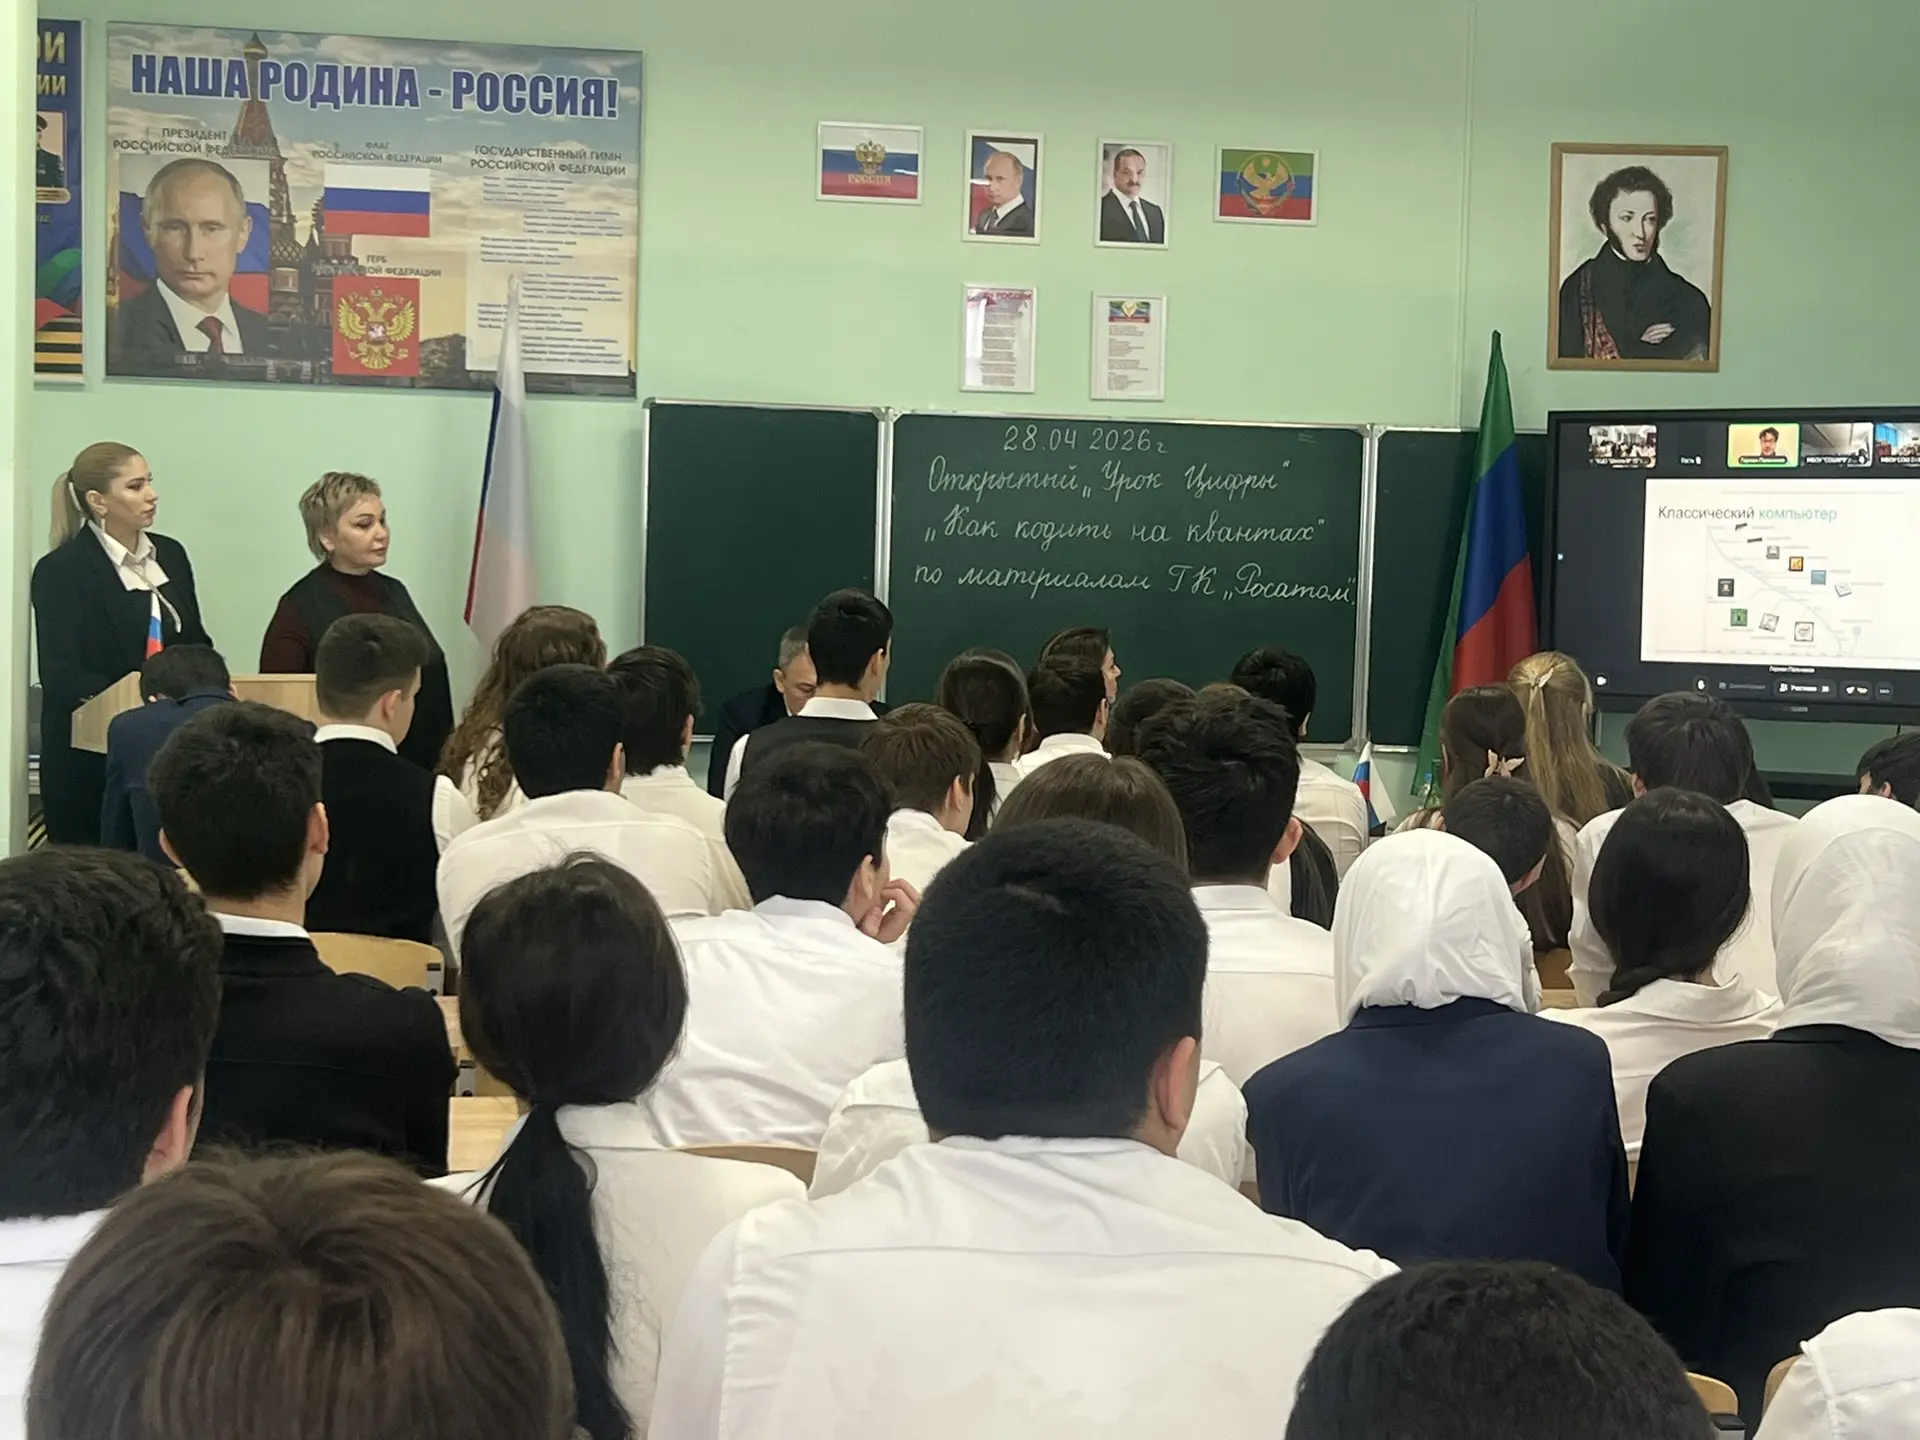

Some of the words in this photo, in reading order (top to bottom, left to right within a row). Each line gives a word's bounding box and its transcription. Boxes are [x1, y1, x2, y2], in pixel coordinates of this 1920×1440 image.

[131, 54, 251, 99] НАША
[258, 60, 421, 109] РОДИНА
[428, 88, 442, 97] -
[451, 70, 618, 118] РОССИЯ!
[162, 127, 227, 141] ПРЕЗИДЕНТ
[113, 140, 202, 153] РОССИЙСКОЙ
[365, 142, 390, 150] ФЛАГ
[474, 145, 586, 160] ГОСУДАРСТВЕННЫЙ
[590, 151, 622, 161] ГИМН
[312, 150, 384, 161] РОССИЙСКОЙ
[385, 153, 442, 164] ФЕДЕРАЦИИ
[471, 159, 555, 172] РОССИЙСКОЙ
[558, 164, 626, 176] ФЕДЕРАЦИИ
[366, 254, 388, 263] ГЕРБ
[385, 267, 442, 276] ФЕДЕРАЦИИ
[1003, 424, 1077, 451] 28.04
[929, 455, 1079, 503] Открытый
[1657, 506, 1755, 520] Классический
[1758, 507, 1838, 522] компьютер
[1015, 520, 1112, 552] кодить
[1131, 523, 1171, 543] на
[914, 564, 943, 585] по
[958, 567, 1151, 600] материалам
